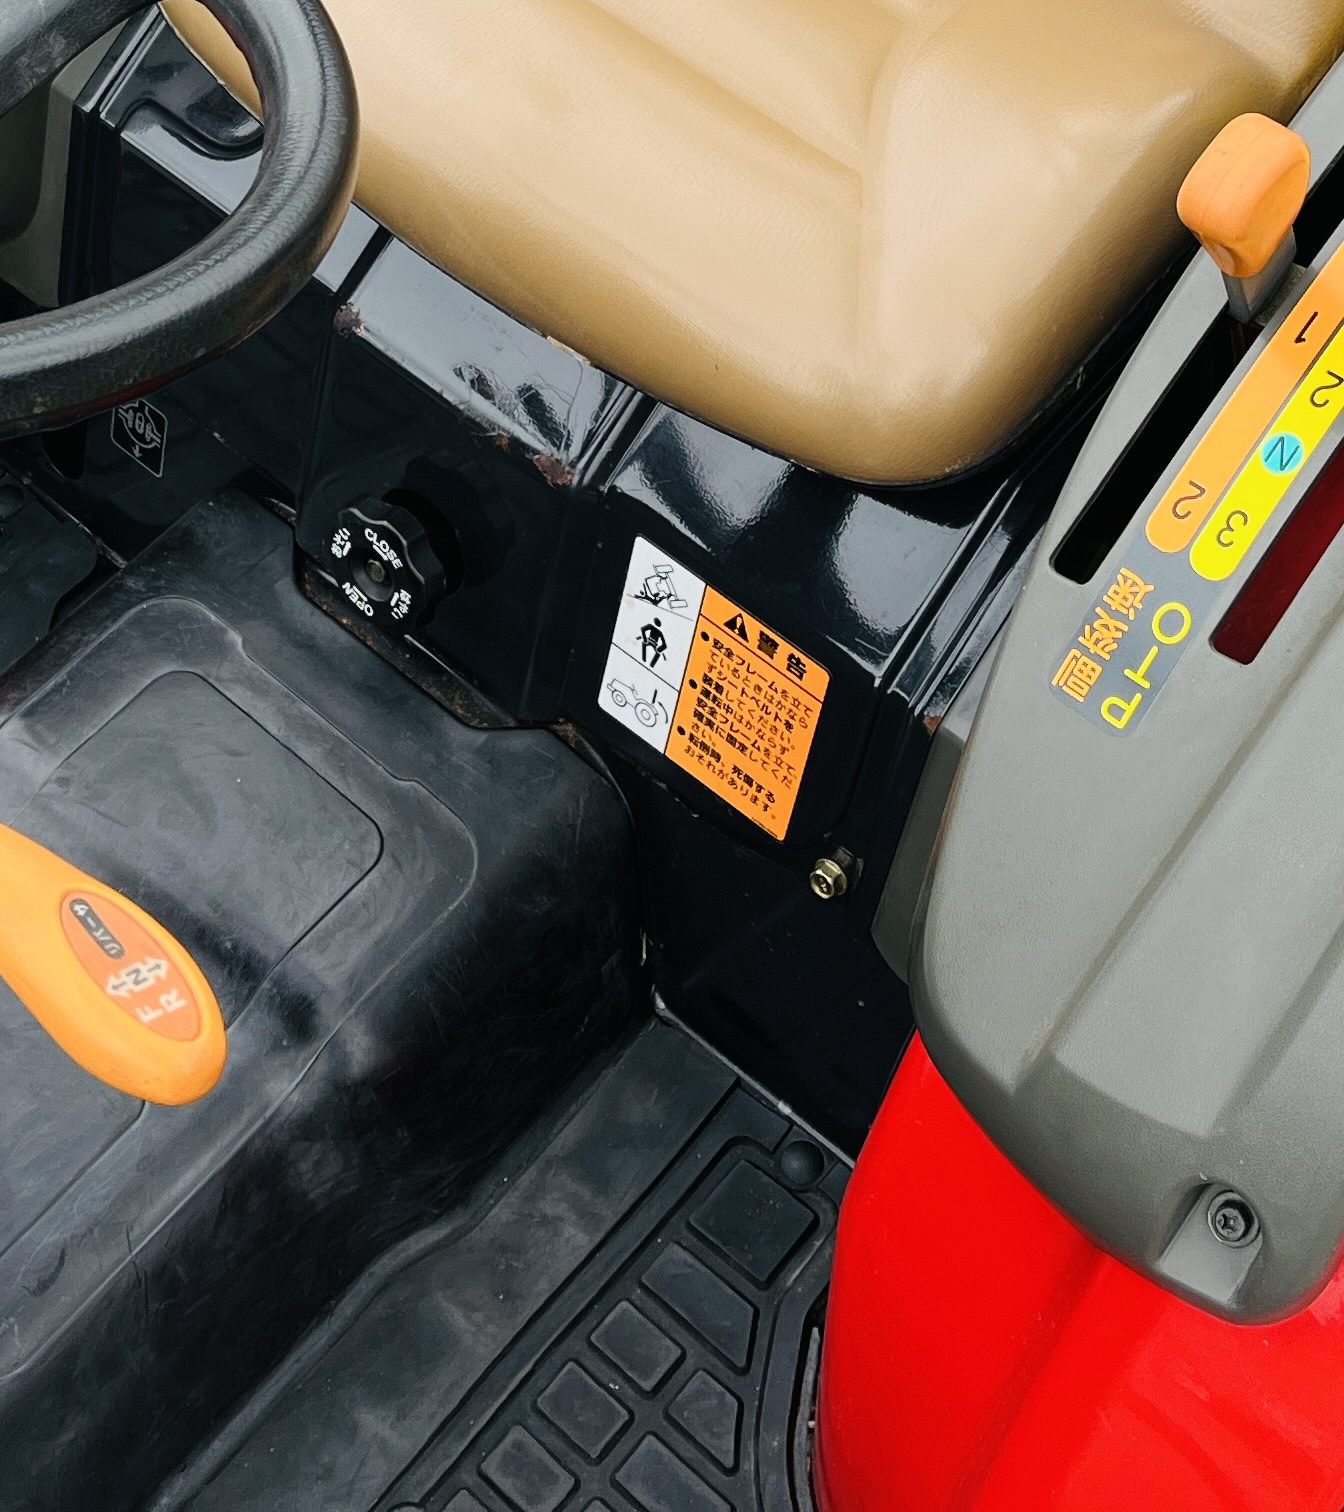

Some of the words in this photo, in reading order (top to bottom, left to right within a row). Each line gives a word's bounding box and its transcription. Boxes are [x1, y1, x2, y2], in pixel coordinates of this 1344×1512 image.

[1294, 310, 1318, 344] 1
[1309, 370, 1344, 409] 2
[1265, 436, 1300, 472] N
[1171, 480, 1206, 520] 2
[364, 528, 403, 569] CLOSE
[1215, 509, 1249, 548] 3
[341, 582, 374, 617] OPEN
[755, 629, 808, 683] 警告
[1052, 566, 1155, 703] 副変速
[711, 637, 813, 719] 安全フレームを立て
[1101, 601, 1192, 729] PTO
[701, 672, 797, 750] 装着してください。
[704, 661, 794, 734] ずシートベルトを
[708, 649, 809, 730] ているときはかなら
[690, 720, 717, 747] さい。
[699, 685, 789, 758] 運転中はかならず
[691, 708, 793, 790] 確実に固定してくだ
[683, 743, 777, 820] おそれがあります。
[72, 902, 121, 956] リバーサ
[125, 968, 148, 987] N
[159, 989, 187, 1012] R
[136, 1004, 162, 1024] F
